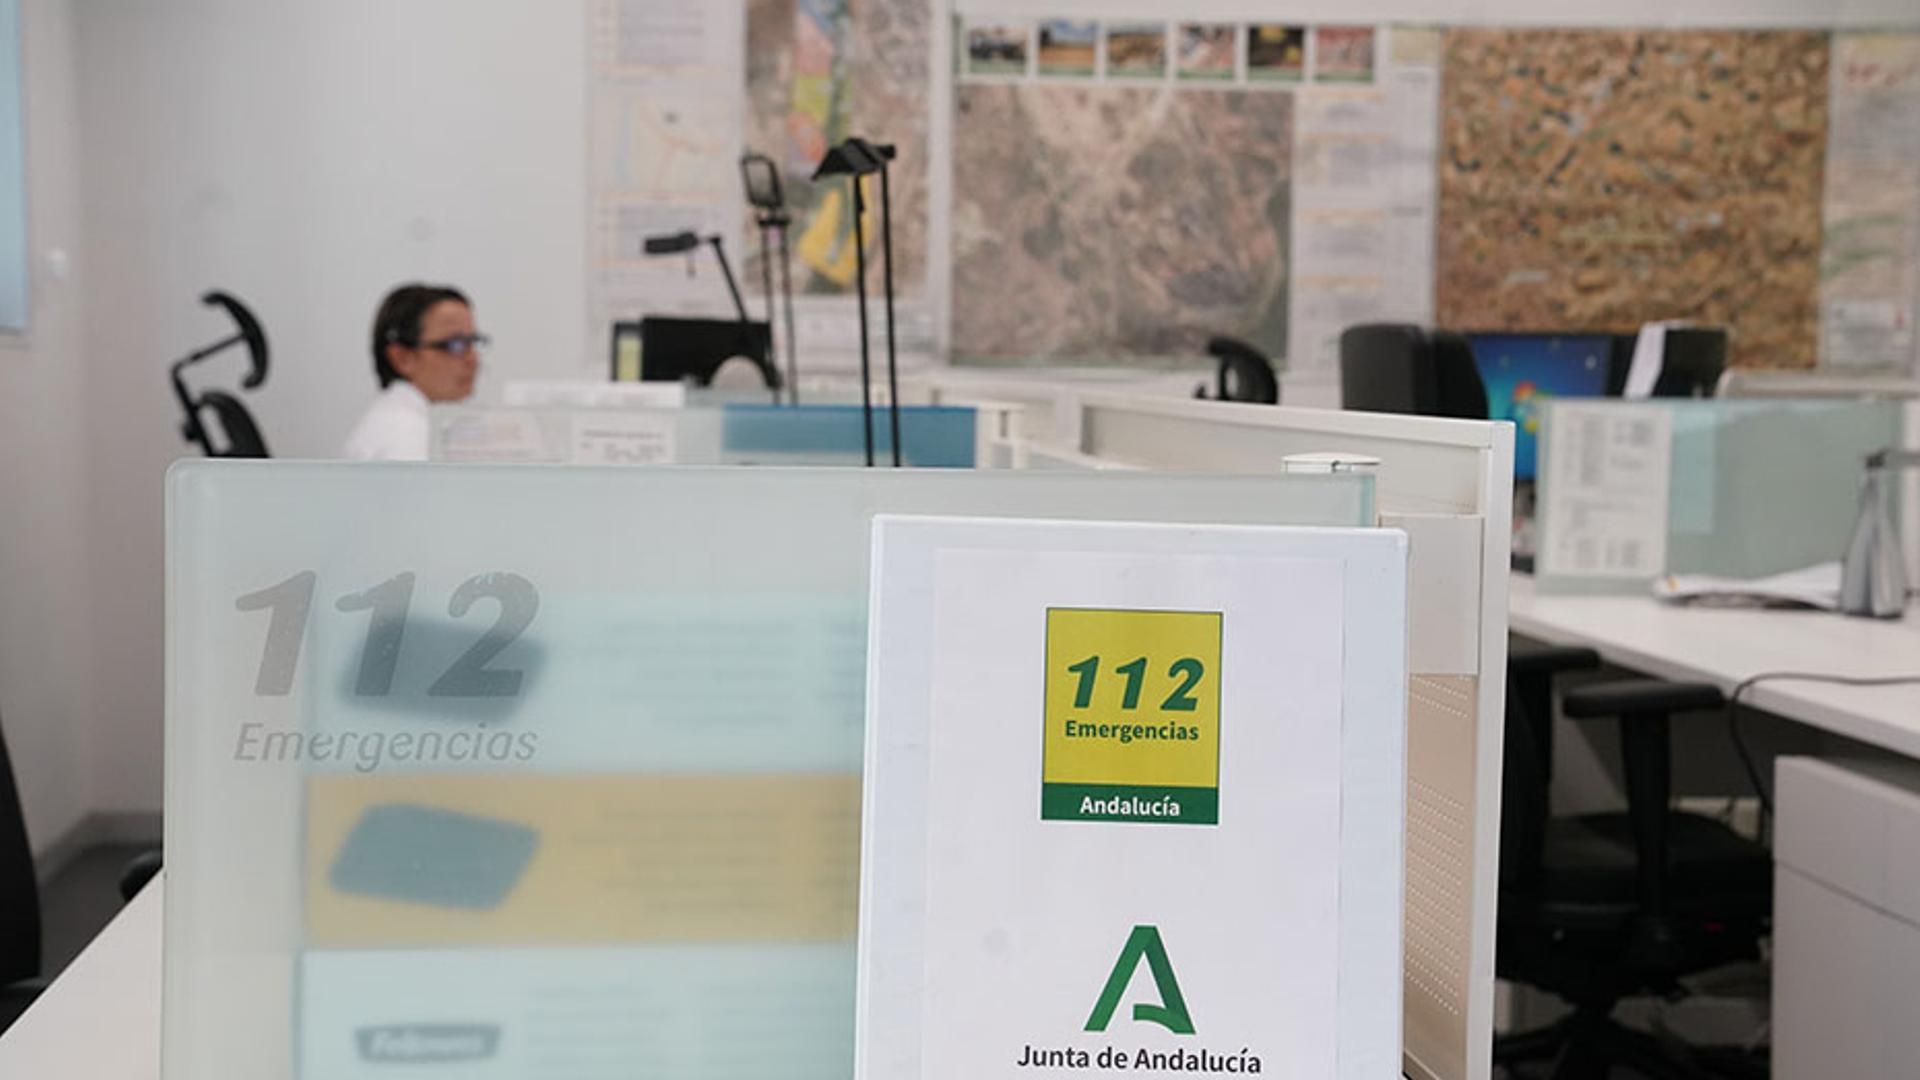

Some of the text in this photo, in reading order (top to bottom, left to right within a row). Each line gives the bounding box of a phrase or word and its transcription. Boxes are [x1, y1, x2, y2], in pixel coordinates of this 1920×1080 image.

[235, 569, 539, 697] 112
[1067, 655, 1205, 712] 112
[233, 722, 539, 773] Emergencias
[1065, 720, 1199, 744] Emergencias
[1080, 796, 1180, 816] Andalucía
[1017, 1045, 1261, 1074] Junta de Andalucía
